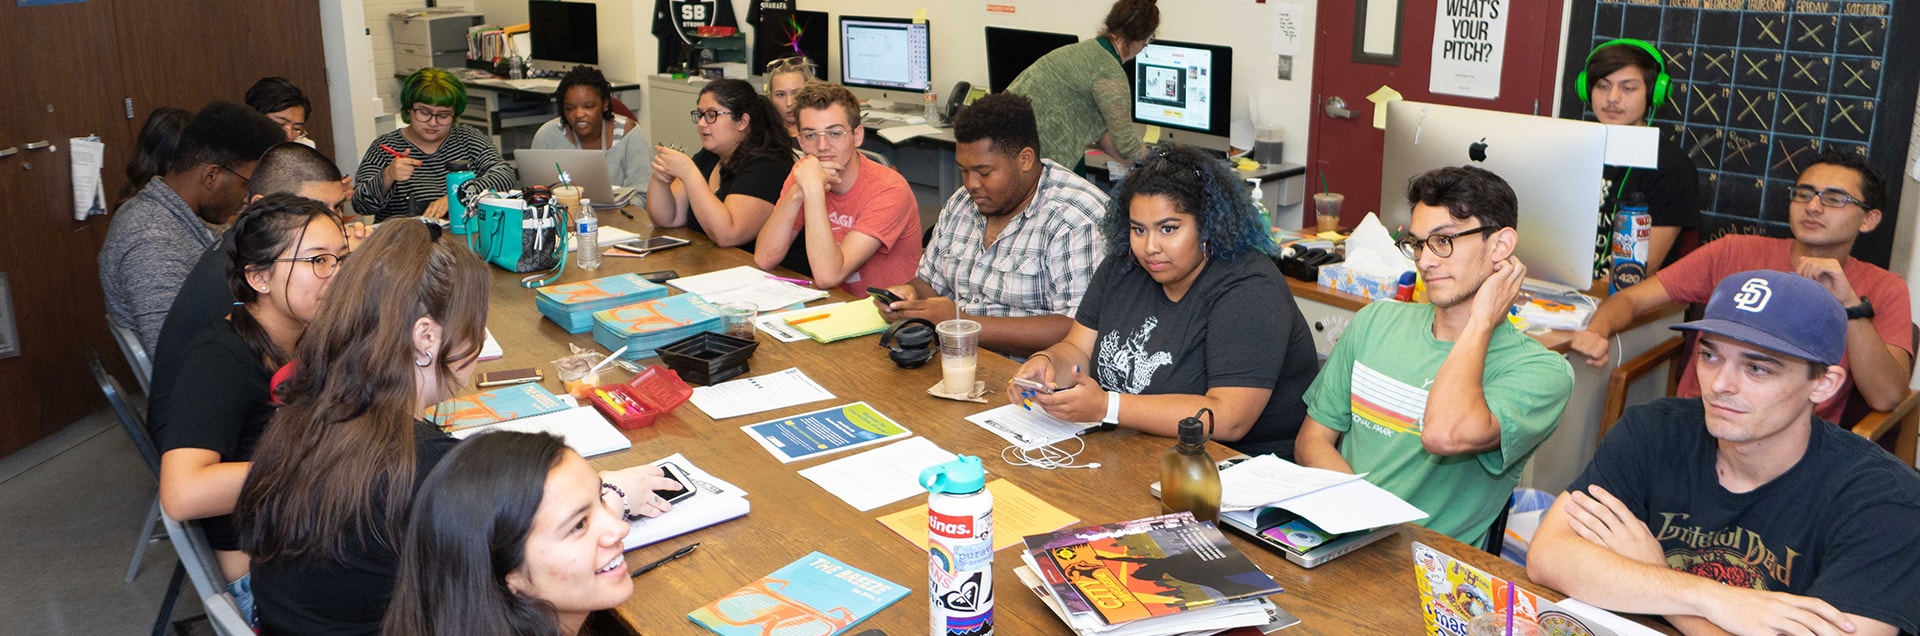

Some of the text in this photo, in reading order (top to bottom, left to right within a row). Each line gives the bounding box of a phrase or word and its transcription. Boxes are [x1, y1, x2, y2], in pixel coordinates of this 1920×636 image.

[681, 4, 705, 20] SB
[1446, 0, 1499, 19] WHAT'S
[1795, 2, 1829, 13] FRIDAY
[1452, 18, 1488, 40] YOUR
[1443, 39, 1493, 63] PITCH?
[1734, 278, 1772, 312] SD
[1656, 512, 1801, 588] Grateful Dead
[809, 557, 843, 575] THE
[834, 569, 893, 595] BREEZE
[1078, 579, 1125, 610] CITY
